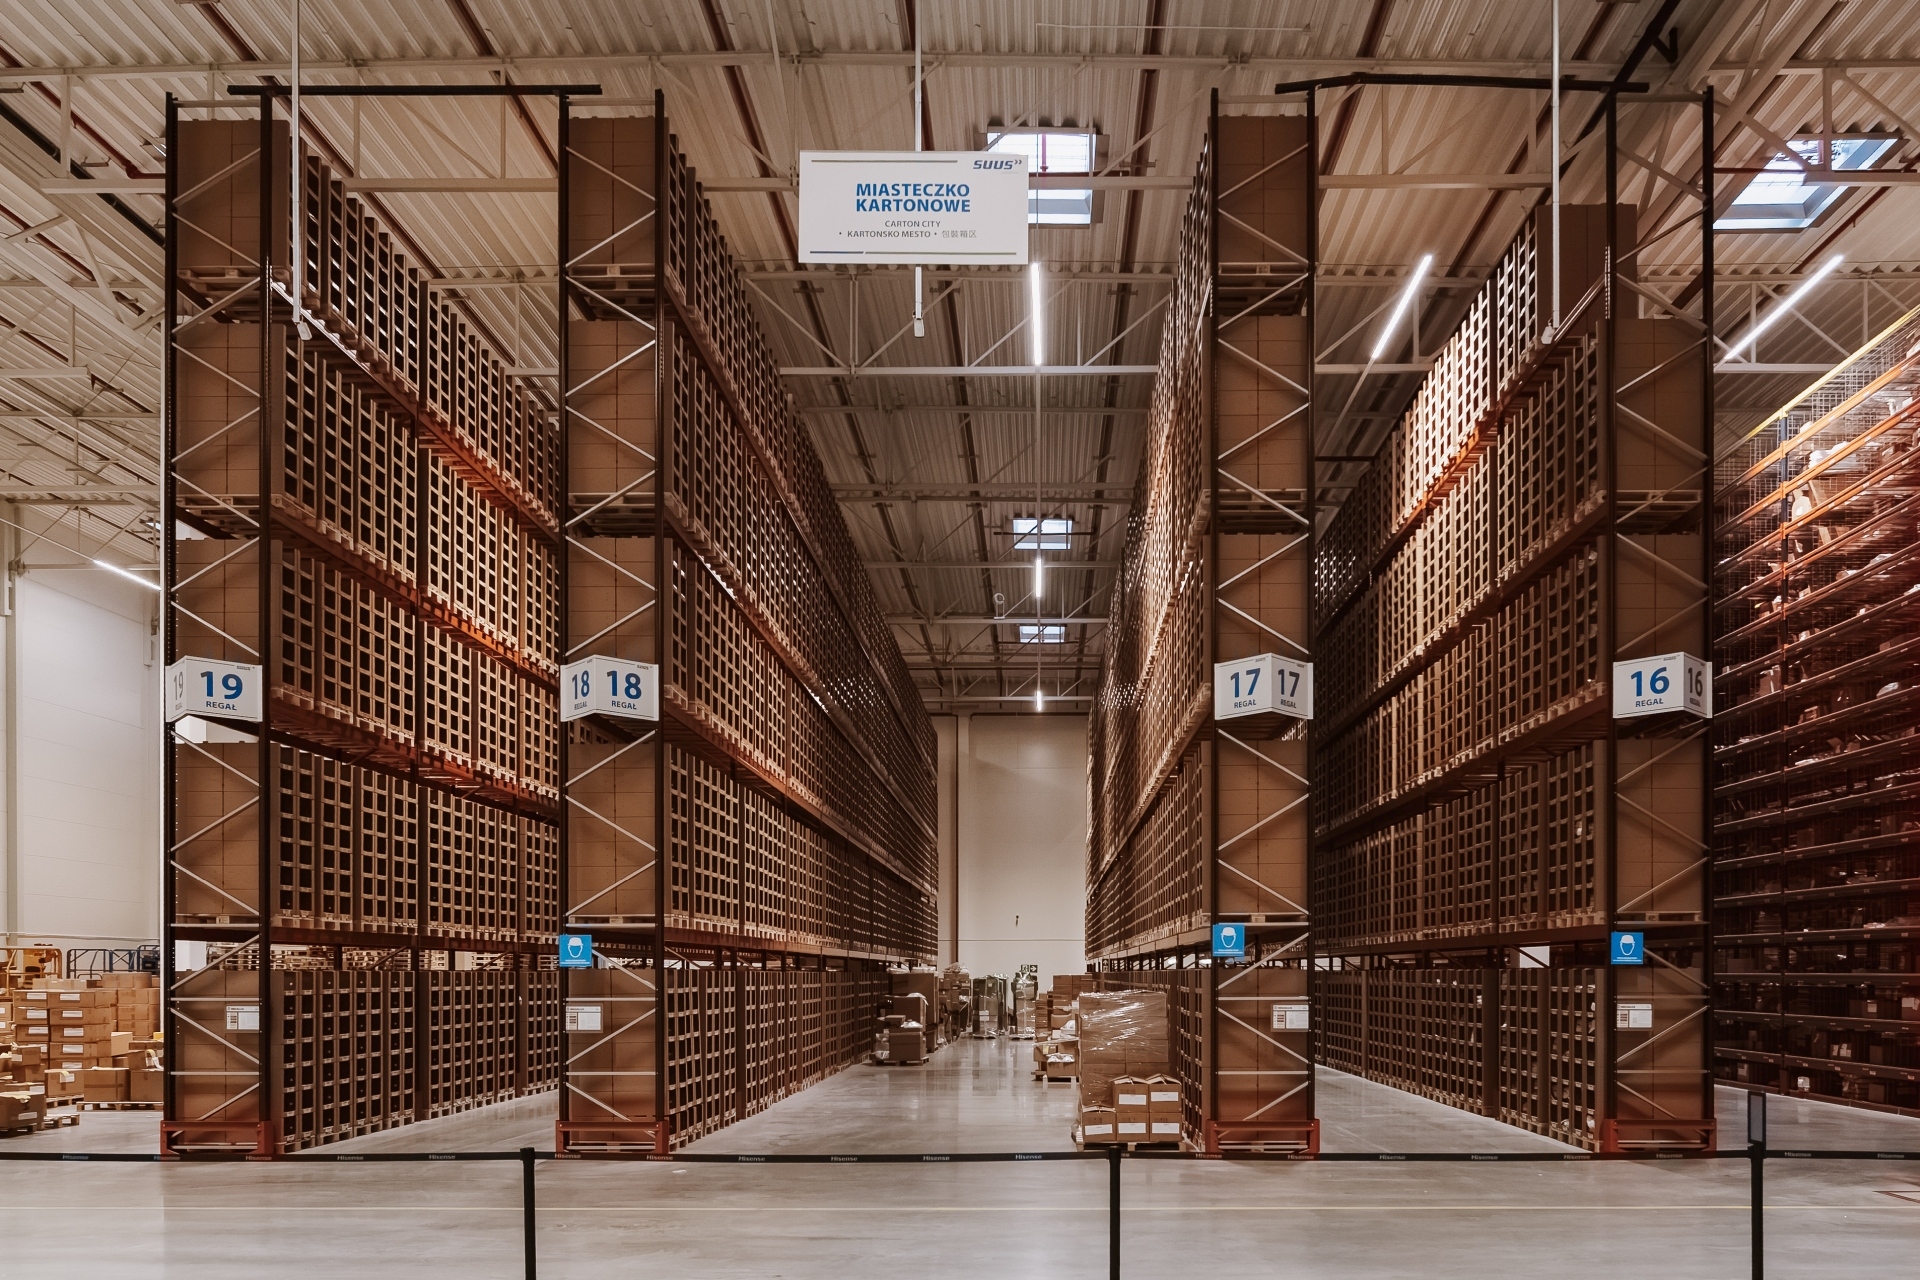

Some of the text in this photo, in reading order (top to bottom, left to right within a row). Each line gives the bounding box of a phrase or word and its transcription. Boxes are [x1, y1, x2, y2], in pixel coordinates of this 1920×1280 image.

[973, 159, 1014, 170] SUUS
[856, 183, 970, 197] MIASTECZKO
[856, 198, 971, 213] KARTONOWE
[884, 220, 941, 228] CARTON CITY
[847, 230, 900, 238] KARTONSKO
[901, 230, 931, 238] MESTO
[174, 671, 184, 701] 19
[200, 671, 243, 700] 19
[571, 670, 590, 700] 18
[606, 670, 642, 700] 18
[1230, 668, 1261, 698] 17
[1278, 668, 1300, 698] 17
[1630, 666, 1670, 697] 16
[1688, 667, 1703, 697] 16
[206, 700, 237, 711] REGAŁ
[611, 700, 637, 710] REGAŁ
[1234, 699, 1257, 709] REGAŁ
[1635, 698, 1664, 708] REGAŁ
